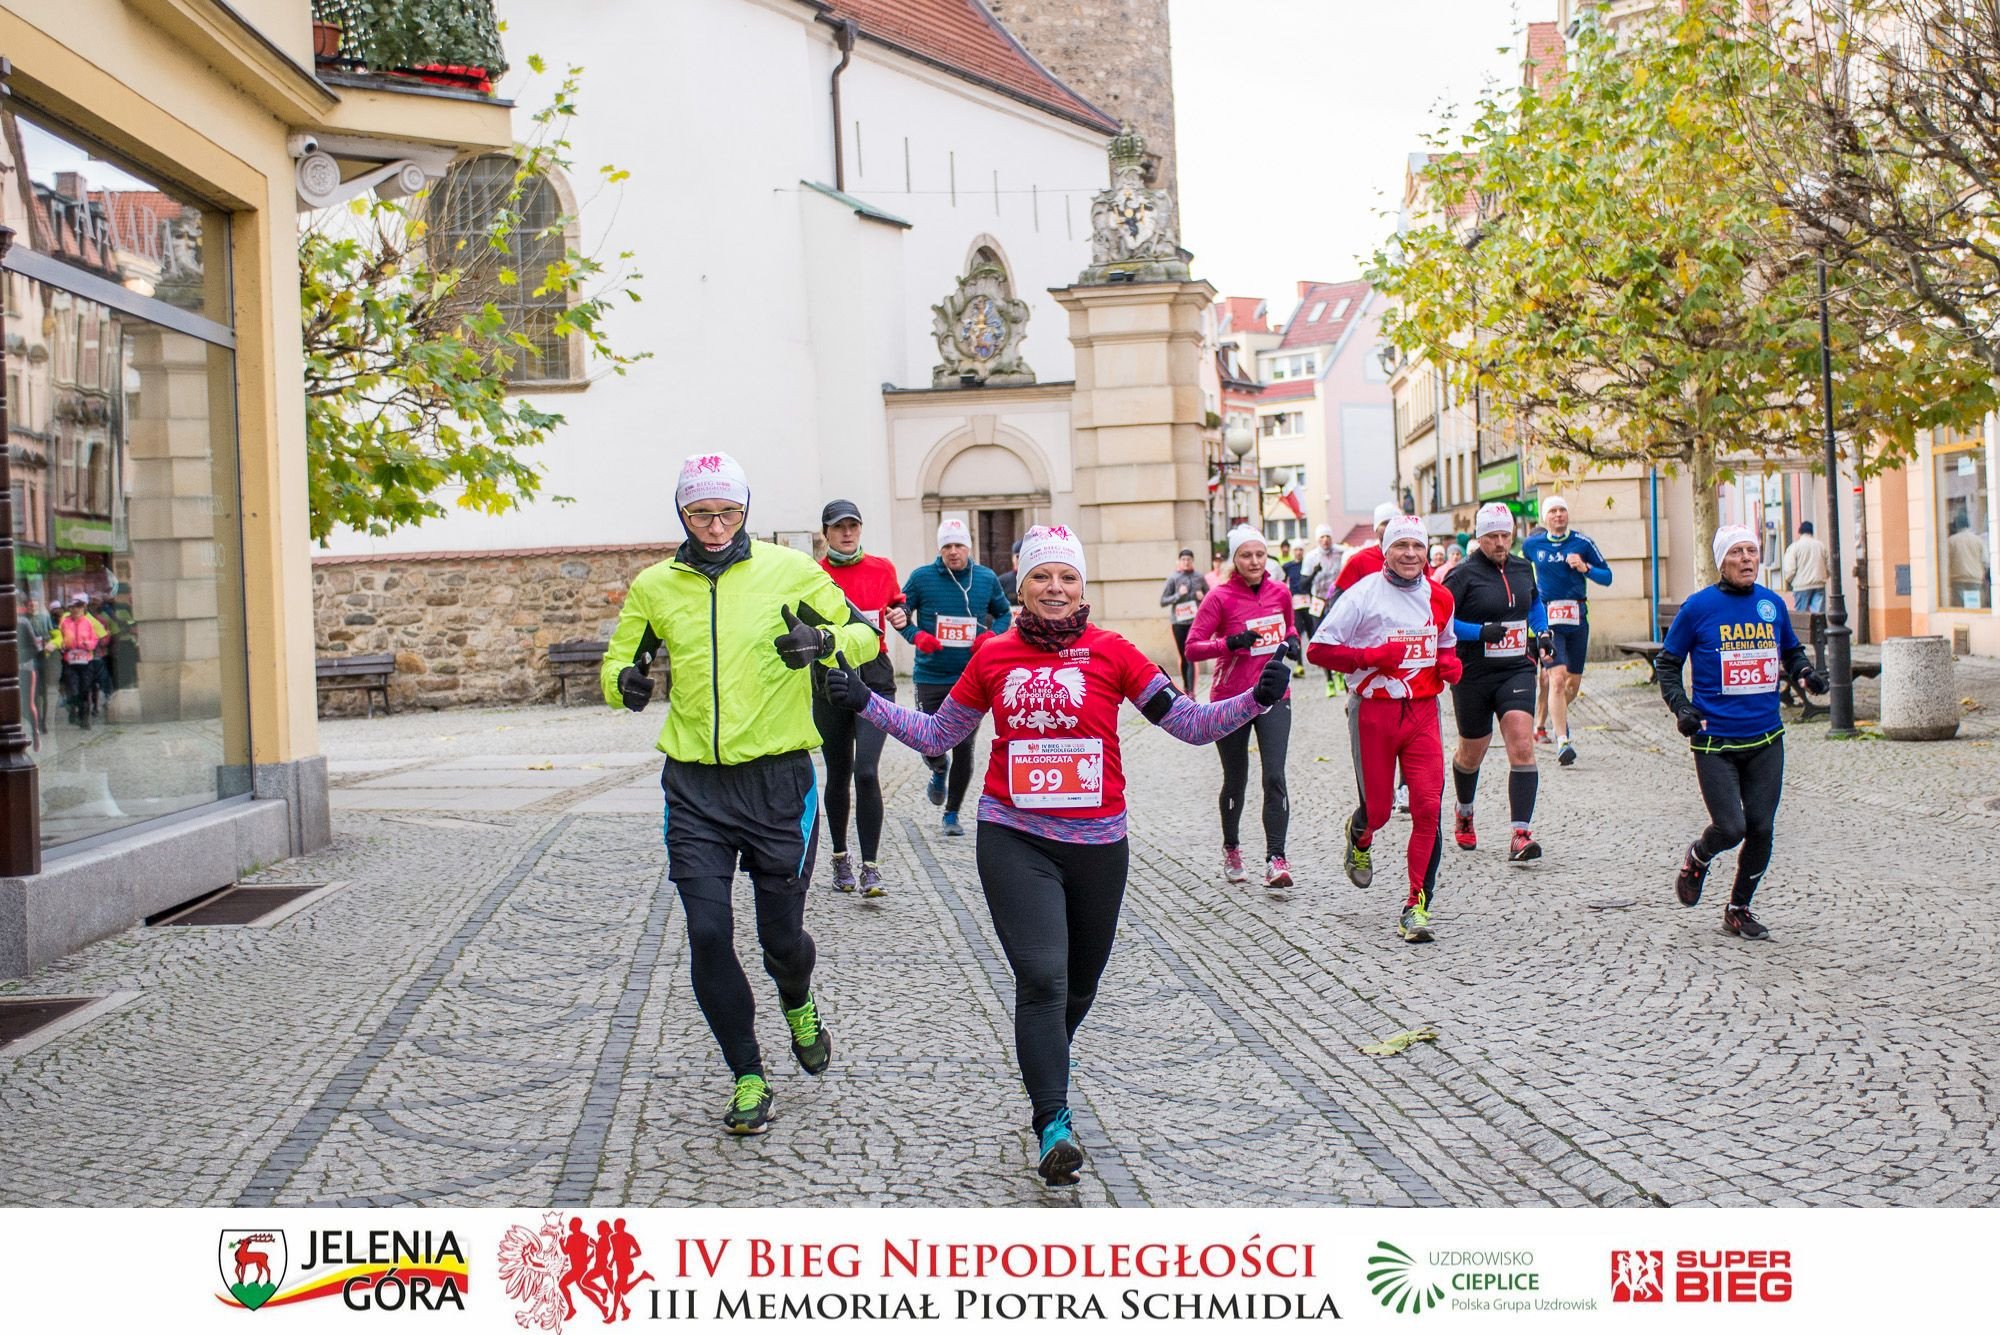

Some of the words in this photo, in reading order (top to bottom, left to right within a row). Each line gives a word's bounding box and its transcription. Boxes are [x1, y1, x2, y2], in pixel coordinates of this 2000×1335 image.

[942, 629, 963, 640] 183
[1720, 623, 1775, 641] RADAR
[1720, 641, 1755, 651] JELENIA
[1730, 668, 1761, 684] 596
[1015, 756, 1073, 764] MAŁGORZATA
[1029, 769, 1063, 792] 99
